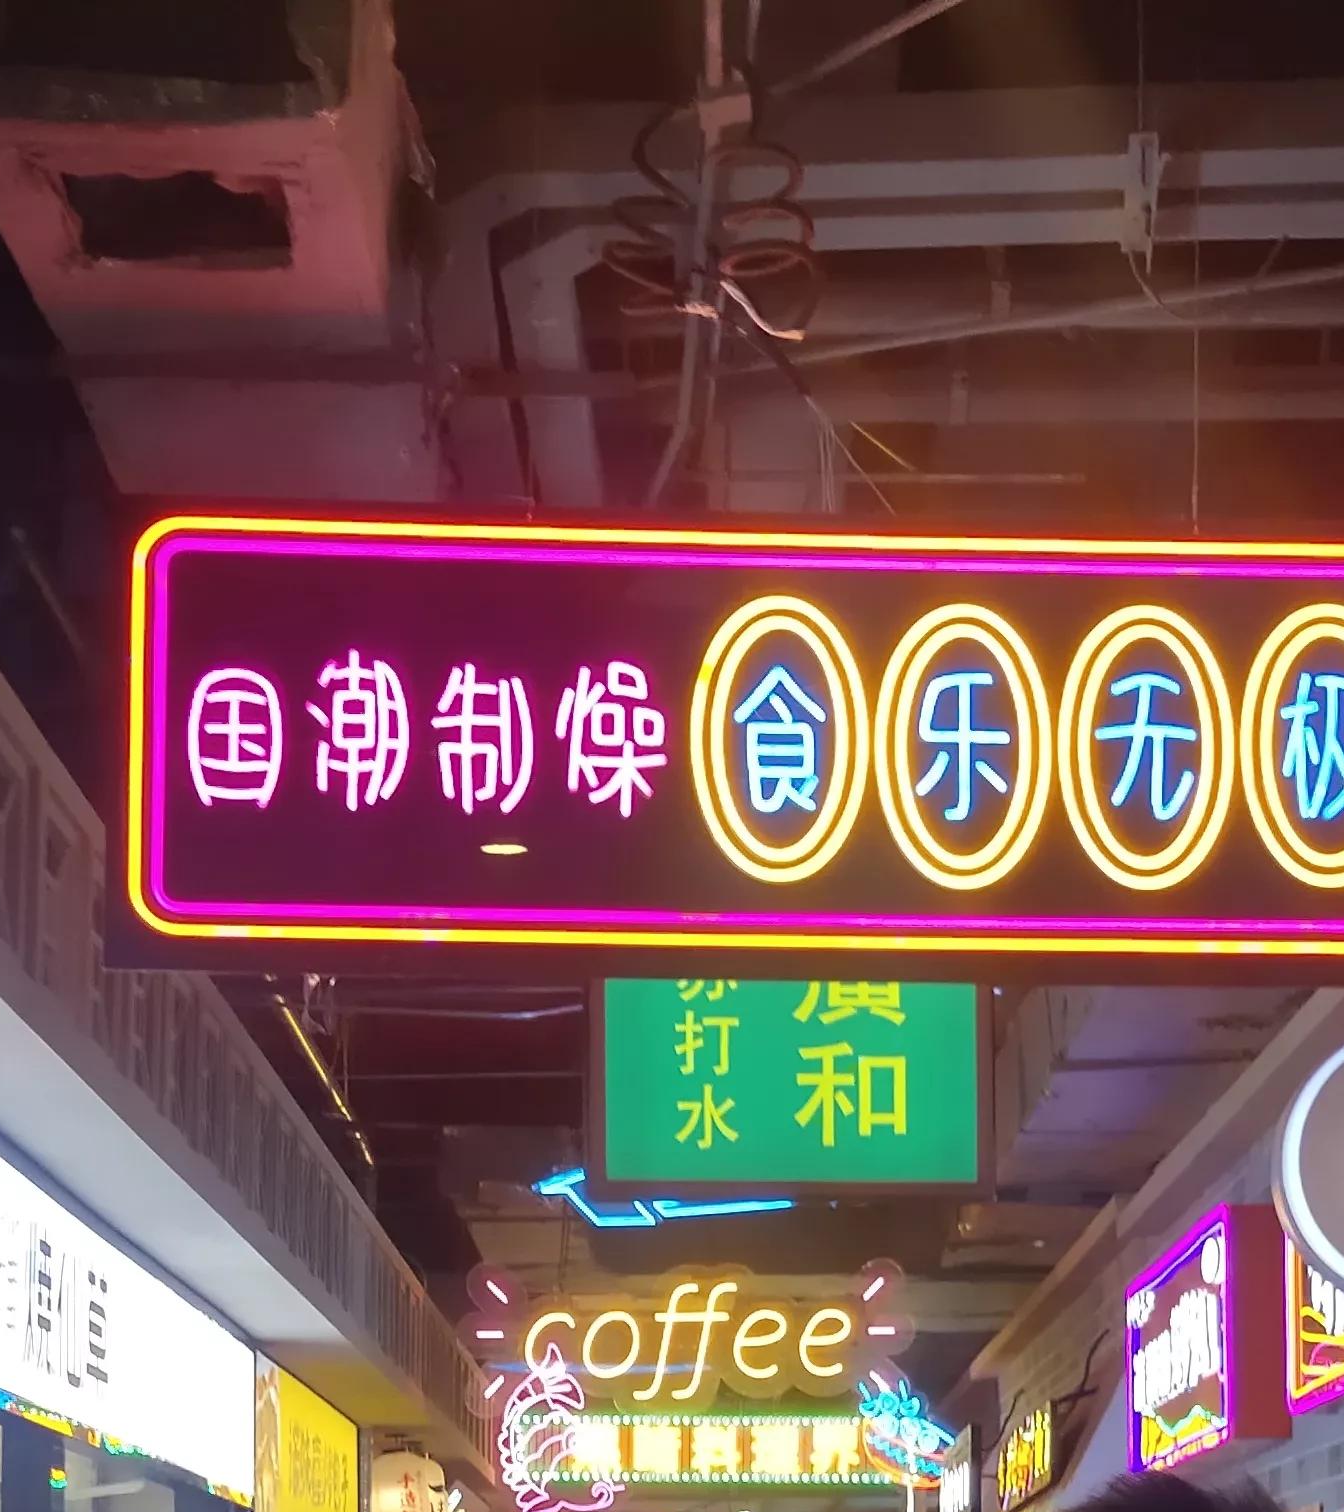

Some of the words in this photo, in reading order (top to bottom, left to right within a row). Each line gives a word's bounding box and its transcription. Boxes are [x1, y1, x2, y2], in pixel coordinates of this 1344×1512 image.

[187, 649, 667, 820] 国潮制燥
[524, 1281, 853, 1400] coffee
